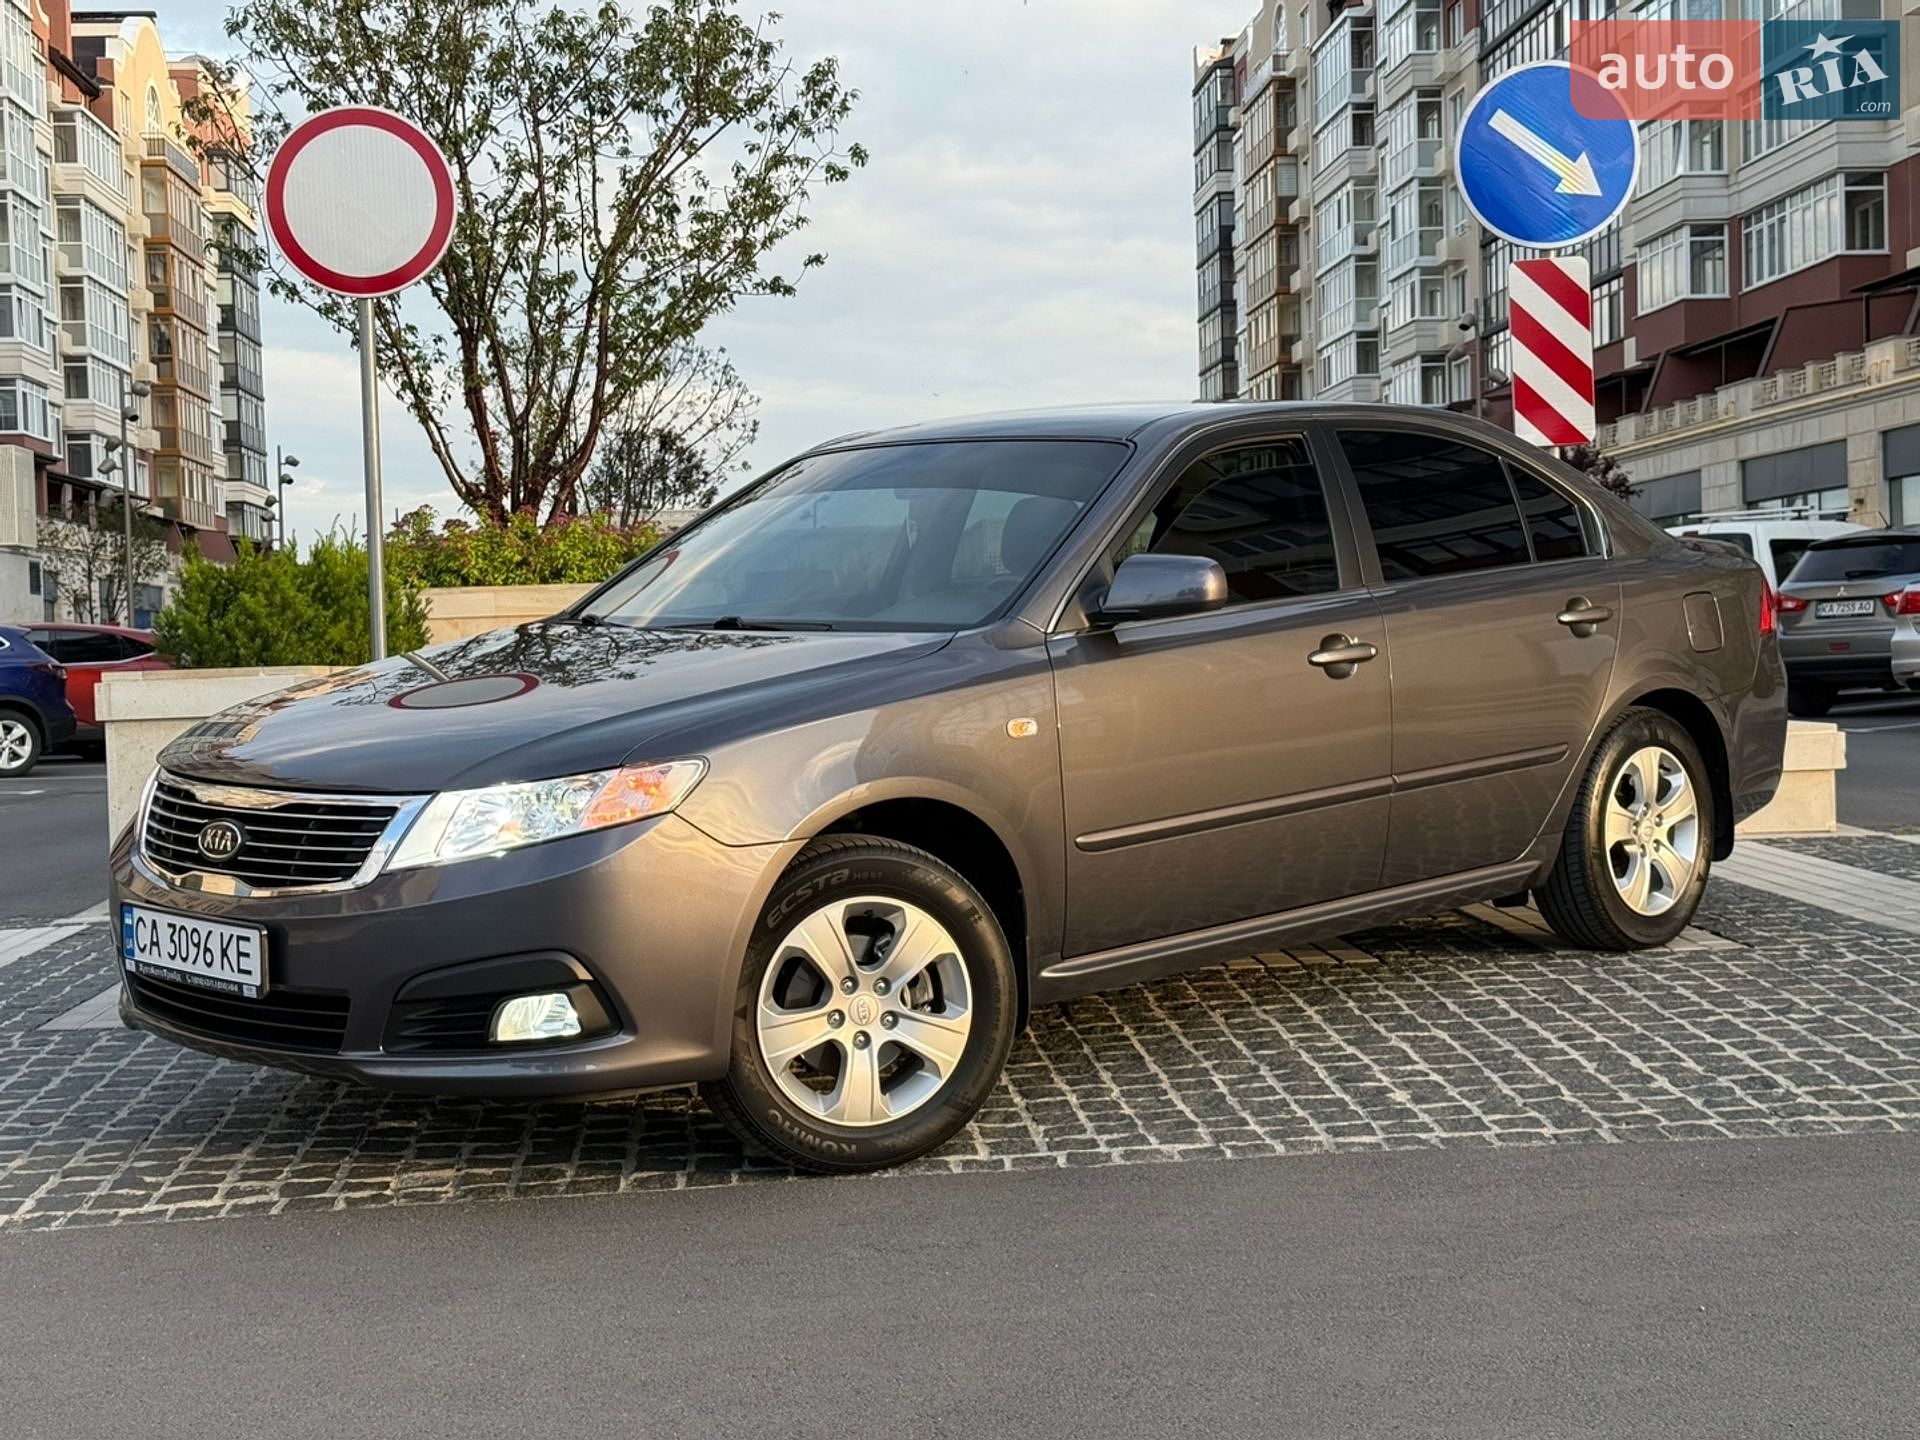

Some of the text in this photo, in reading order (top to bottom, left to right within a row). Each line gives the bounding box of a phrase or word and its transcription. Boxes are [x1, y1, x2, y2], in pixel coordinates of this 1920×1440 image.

[204, 829, 231, 851] KIA
[134, 916, 253, 976] CA 3096 KE
